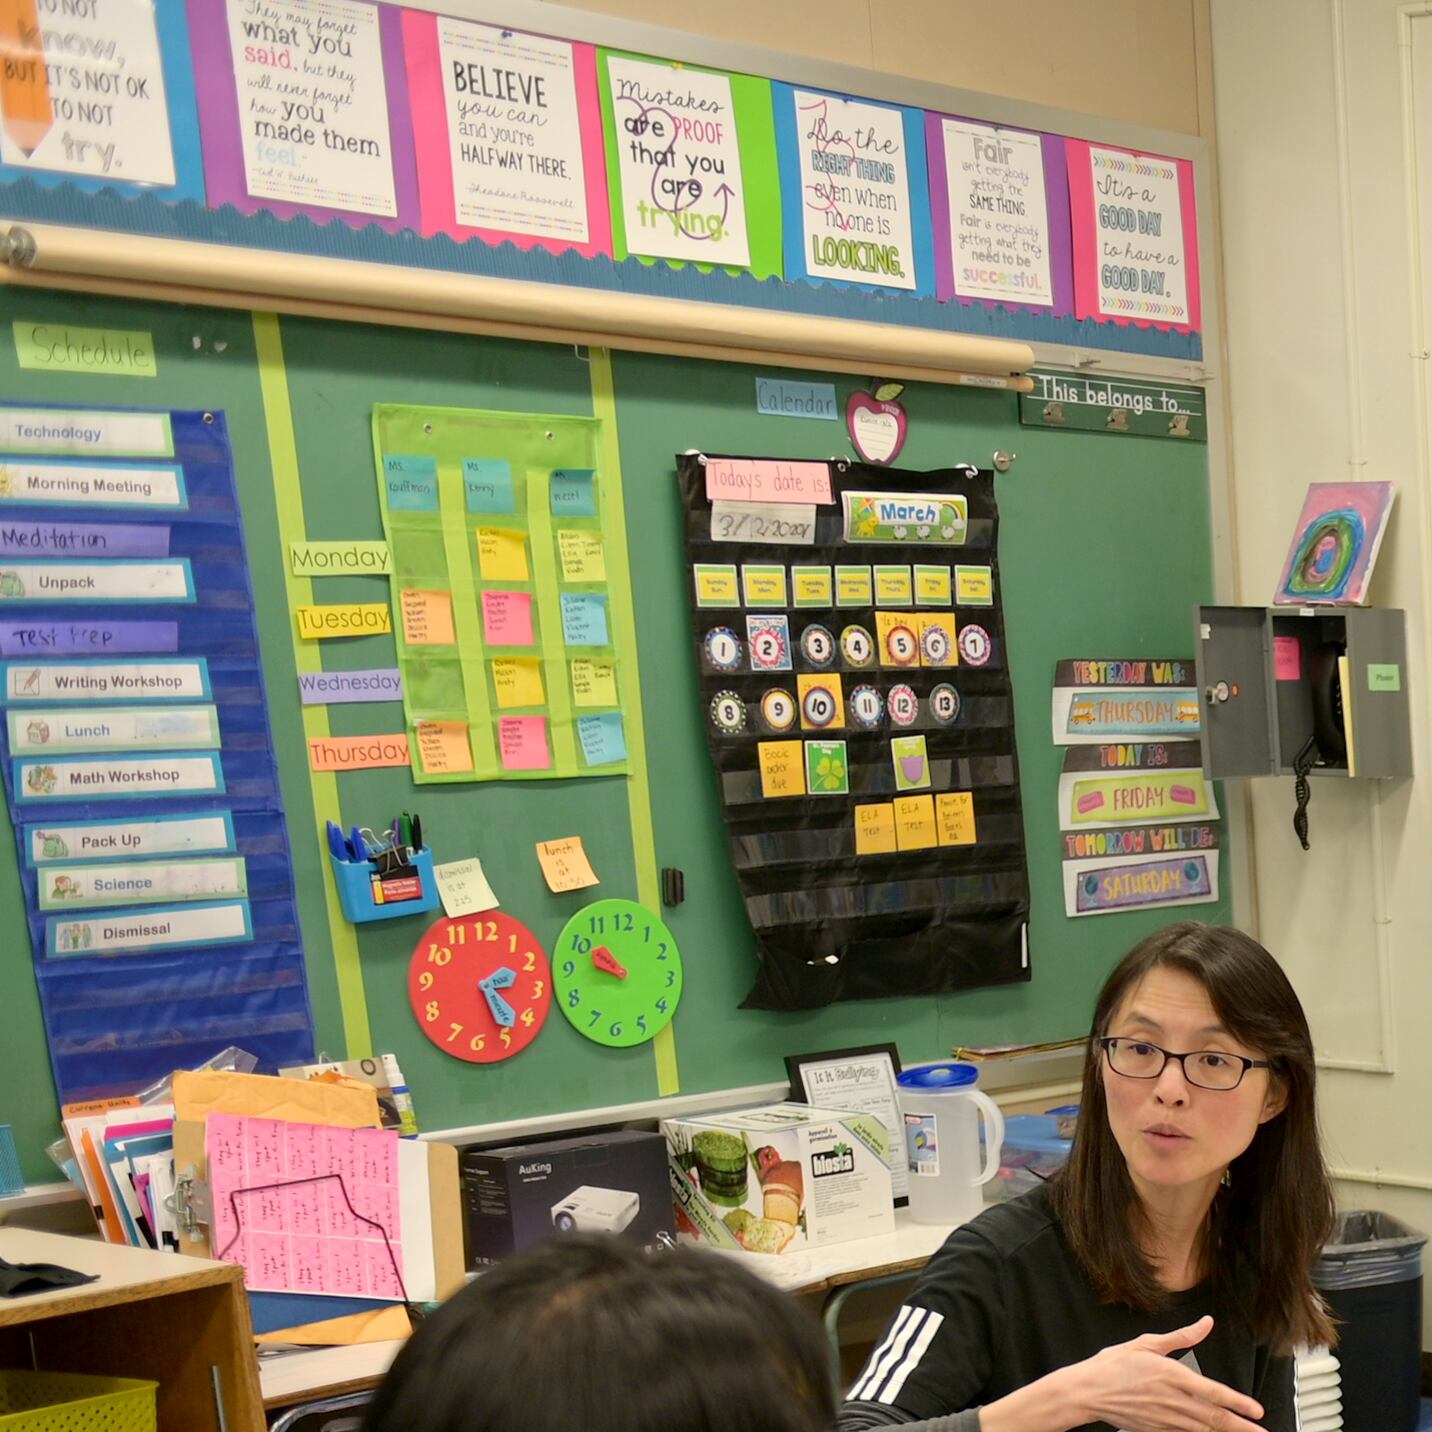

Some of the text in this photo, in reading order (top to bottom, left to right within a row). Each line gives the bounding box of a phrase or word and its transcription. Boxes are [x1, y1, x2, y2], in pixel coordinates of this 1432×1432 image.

[241, 21, 352, 57] what you
[3, 57, 149, 99] BUT IT'S NOT OK
[453, 61, 548, 108] BELIEVE
[616, 79, 725, 113] Mistakes
[52, 97, 114, 126] TO NOT
[457, 100, 548, 128] you can
[255, 120, 381, 157] made them
[458, 121, 535, 148] and you're
[625, 115, 724, 145] are PROOF
[807, 118, 899, 155] Do the
[62, 129, 123, 172] try.
[460, 142, 571, 180] HALFWAY THERE.
[630, 140, 725, 176] that you
[973, 137, 1013, 165] Fair
[812, 150, 896, 184] RIGHT THING
[661, 177, 702, 200] are
[814, 182, 897, 212] even when
[1097, 175, 1156, 202] It's a
[637, 200, 729, 240] trying.
[1098, 204, 1163, 236] GOOD DAY
[812, 235, 906, 278] LOOKING.
[1104, 243, 1119, 260] to
[1124, 243, 1164, 267] have
[1100, 264, 1173, 299] GOOD DAY.
[32, 326, 152, 367] Schedule
[759, 384, 833, 412] Calendar
[1039, 374, 1191, 415] This belongs to...
[15, 423, 102, 442] Technology
[27, 476, 152, 496] Morning Meeting
[709, 459, 829, 498] Today's date is:
[881, 503, 936, 522] March
[2, 527, 107, 550] Meditation
[292, 547, 389, 571] Monday
[39, 575, 95, 592] Unpack
[298, 607, 389, 630] Tuesday
[763, 638, 772, 654] 2
[814, 637, 823, 654] 3
[853, 637, 862, 653] 4
[898, 637, 907, 653] 5
[931, 638, 941, 653] 6
[969, 638, 978, 655] 7
[55, 675, 183, 690] Writing Workshop
[300, 673, 400, 692] Wednesday
[1073, 661, 1184, 685] YESTERDAY WAS:
[724, 694, 951, 722] 8 9 10 11 12 13
[1096, 700, 1174, 722] THURSDAY
[65, 724, 110, 738] Lunch
[310, 741, 409, 767] Thursday
[1100, 745, 1168, 767] TODAY IS:
[70, 768, 180, 785] Math Workshop
[1113, 786, 1165, 811] FRIDAY
[82, 833, 142, 850] Pack Up
[1066, 827, 1212, 856] TOMORROW WILL BE:
[94, 876, 152, 891] Science
[1103, 870, 1182, 898] SATURDAY
[103, 923, 171, 940] Dismissal
[518, 1162, 552, 1176] AuKing
[814, 1153, 851, 1176] biosta
